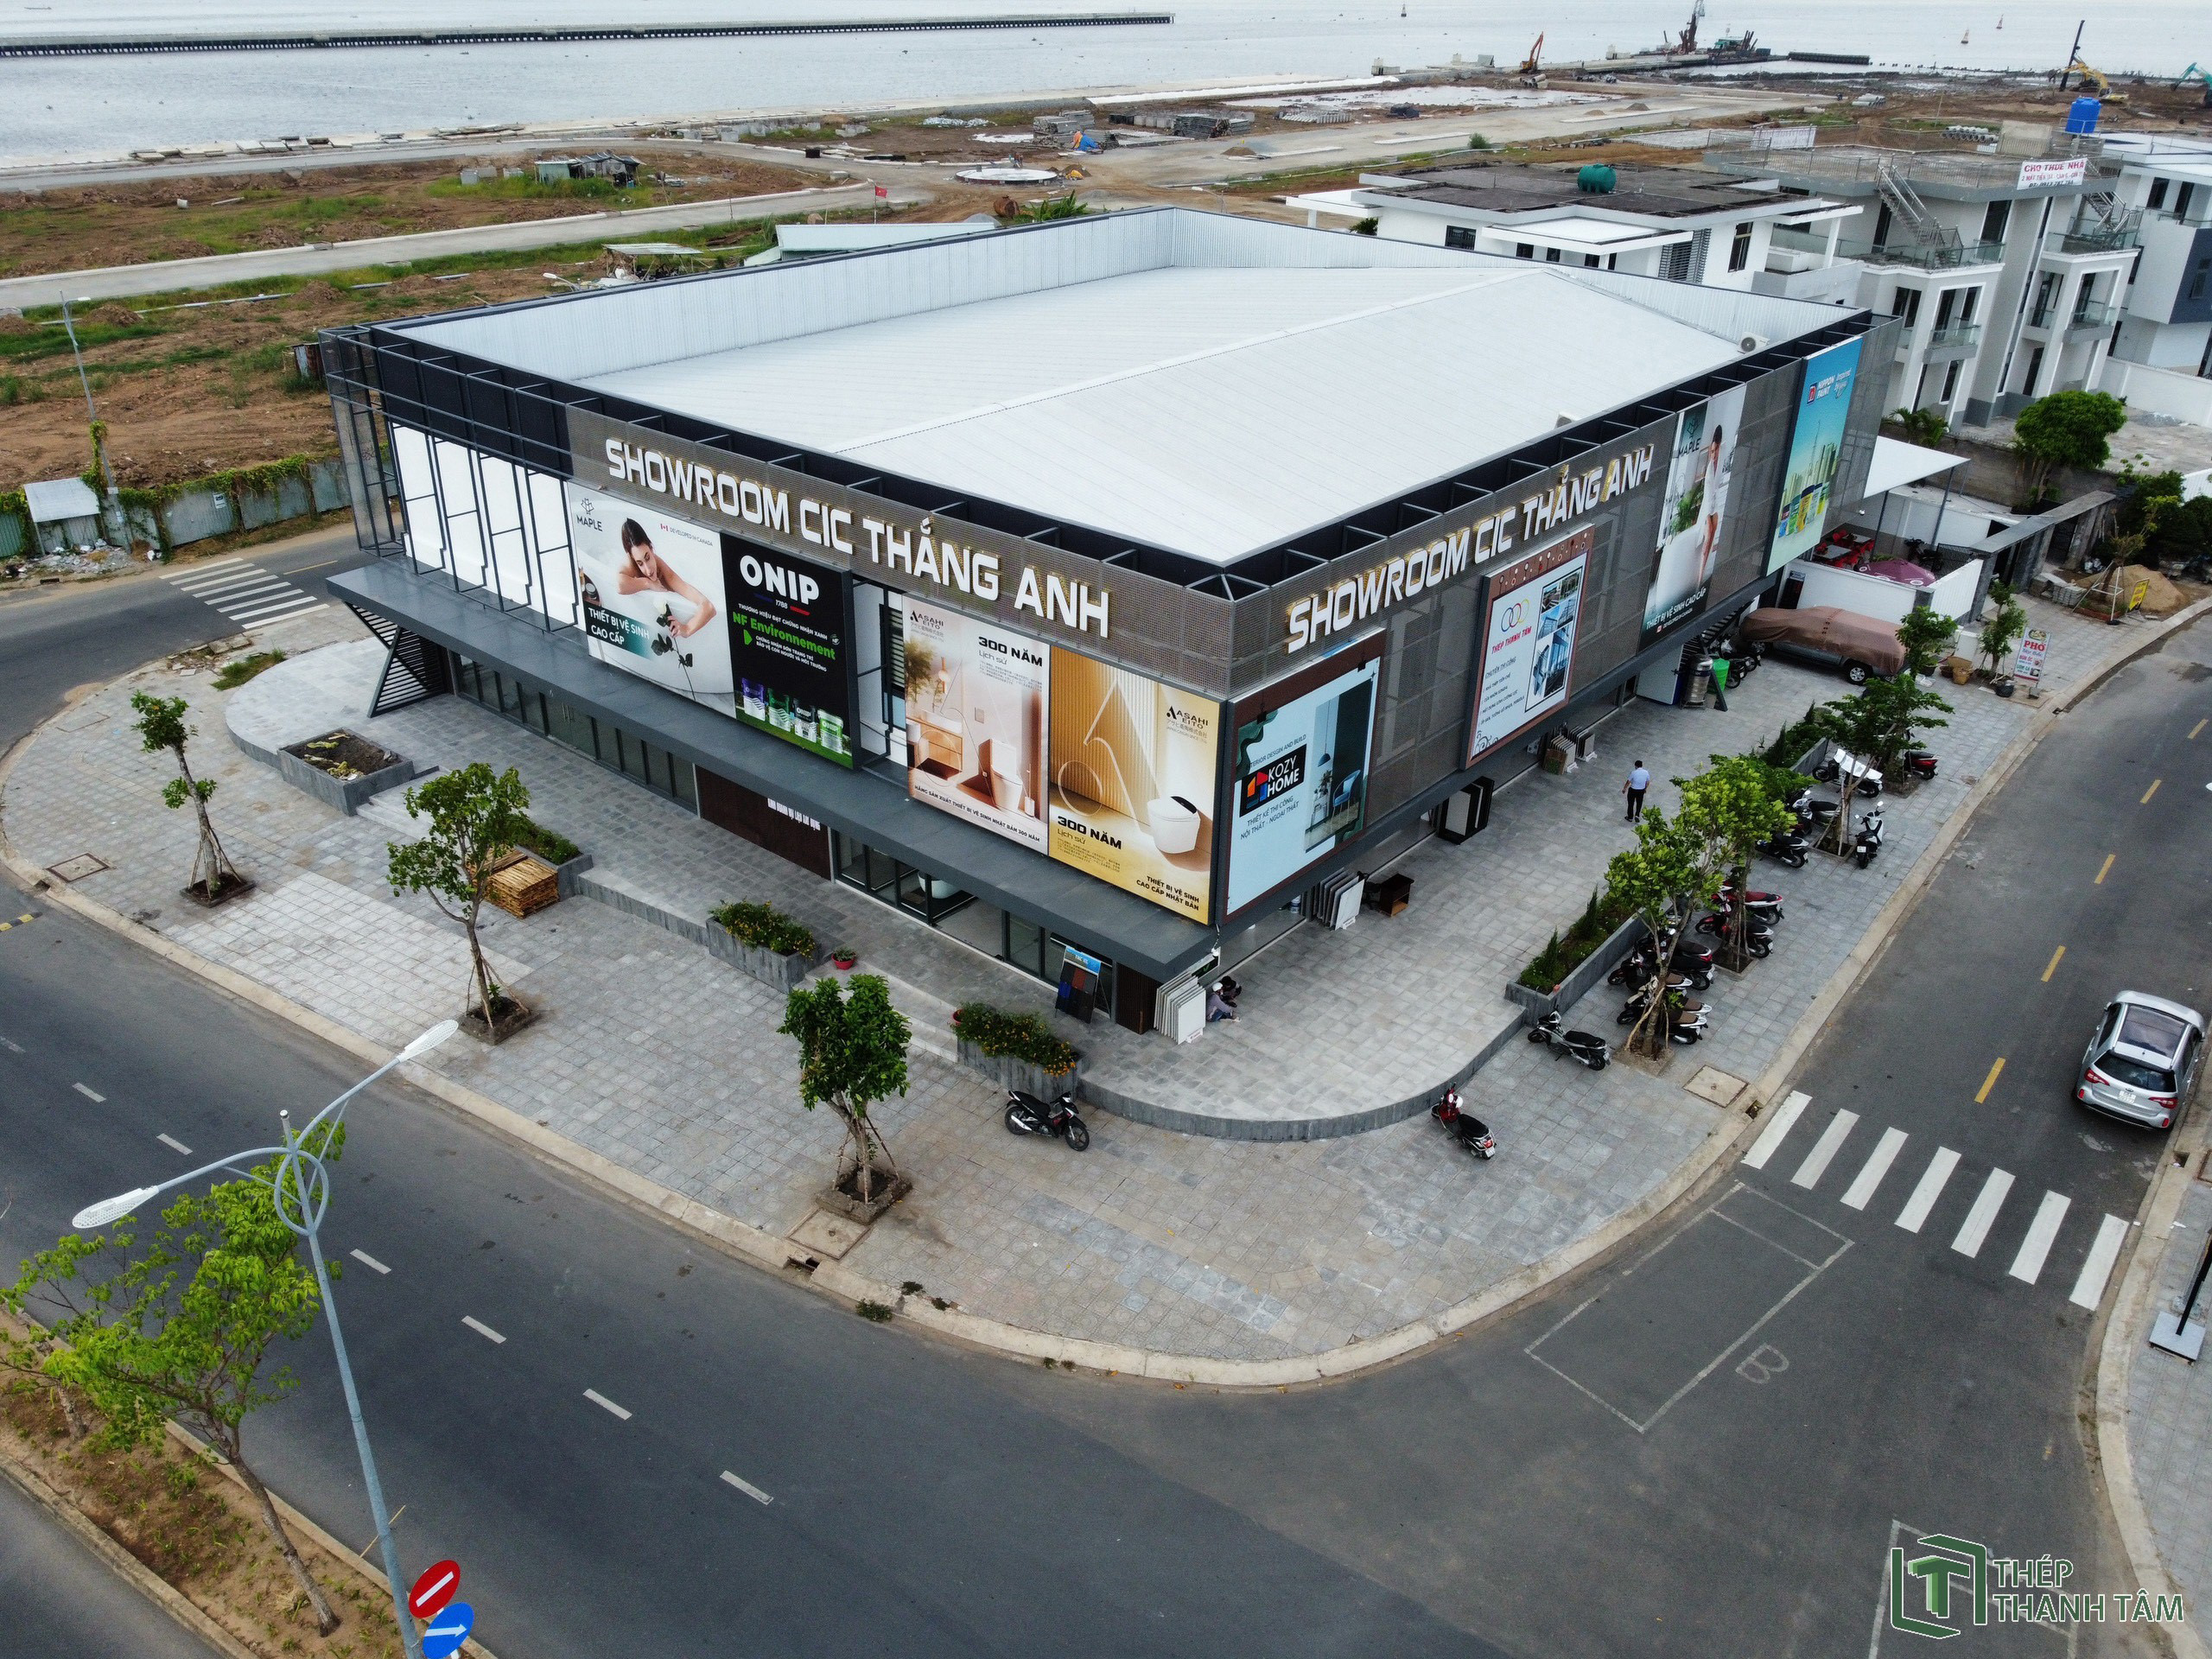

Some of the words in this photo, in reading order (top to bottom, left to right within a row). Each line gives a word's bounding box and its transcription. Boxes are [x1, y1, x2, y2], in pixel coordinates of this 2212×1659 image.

[1678, 437, 1701, 457] MAPLE
[576, 516, 603, 531] MAPLE
[606, 439, 790, 534] SHOWROOM
[800, 499, 854, 555] CIC
[862, 516, 1000, 601] THẮNG
[1014, 567, 1109, 638] ANH
[1287, 528, 1470, 654] SHOWROOM
[1474, 508, 1516, 564] CIC
[1521, 464, 1603, 541] THẮNG
[1604, 444, 1655, 501] ANH
[740, 555, 820, 605] ONIP
[775, 599, 788, 609] 1788
[1646, 614, 1661, 630] THIẾT
[1667, 607, 1674, 619] VỆ
[1673, 601, 1685, 614] SINH
[1685, 594, 1696, 607] CAO
[1696, 587, 1707, 600] CẤP
[588, 607, 610, 624] THIẾT
[611, 615, 619, 630] BỊ
[619, 619, 630, 633] VỆ
[631, 624, 649, 639] SINH
[918, 613, 944, 626] ASAHI
[923, 620, 940, 630] EITO
[591, 625, 607, 639] CAO
[609, 630, 625, 645] CẤP
[732, 611, 747, 626] NF
[750, 617, 836, 660] Environnement
[814, 631, 828, 640] XANH
[978, 636, 1007, 654] 300
[1011, 647, 1043, 667] NĂM
[978, 649, 995, 661] Lịch
[2024, 640, 2046, 652] PHỞ
[1176, 709, 1209, 726] ASAHI
[1182, 717, 1204, 729] EITO
[1284, 741, 1294, 751] AND
[1294, 734, 1306, 746] BUILD
[1268, 755, 1297, 783] KOZY
[1267, 767, 1300, 798] HOME
[1269, 804, 1279, 813] THI
[1279, 795, 1294, 808] CÔNG
[980, 813, 992, 822] SINH
[1057, 828, 1074, 842] Lịch
[1058, 816, 1086, 835] 300
[1090, 829, 1122, 849] NĂM
[1240, 830, 1251, 840] NỘI
[1136, 880, 1150, 890] CAO
[1151, 884, 1165, 895] CẤP
[1166, 893, 1185, 905] NHẬT
[1185, 898, 1199, 911] BẢN
[1147, 875, 1165, 888] THIẾT
[1166, 883, 1173, 893] BỊ
[1173, 887, 1183, 897] VỆ
[1184, 892, 1199, 903] SINH
